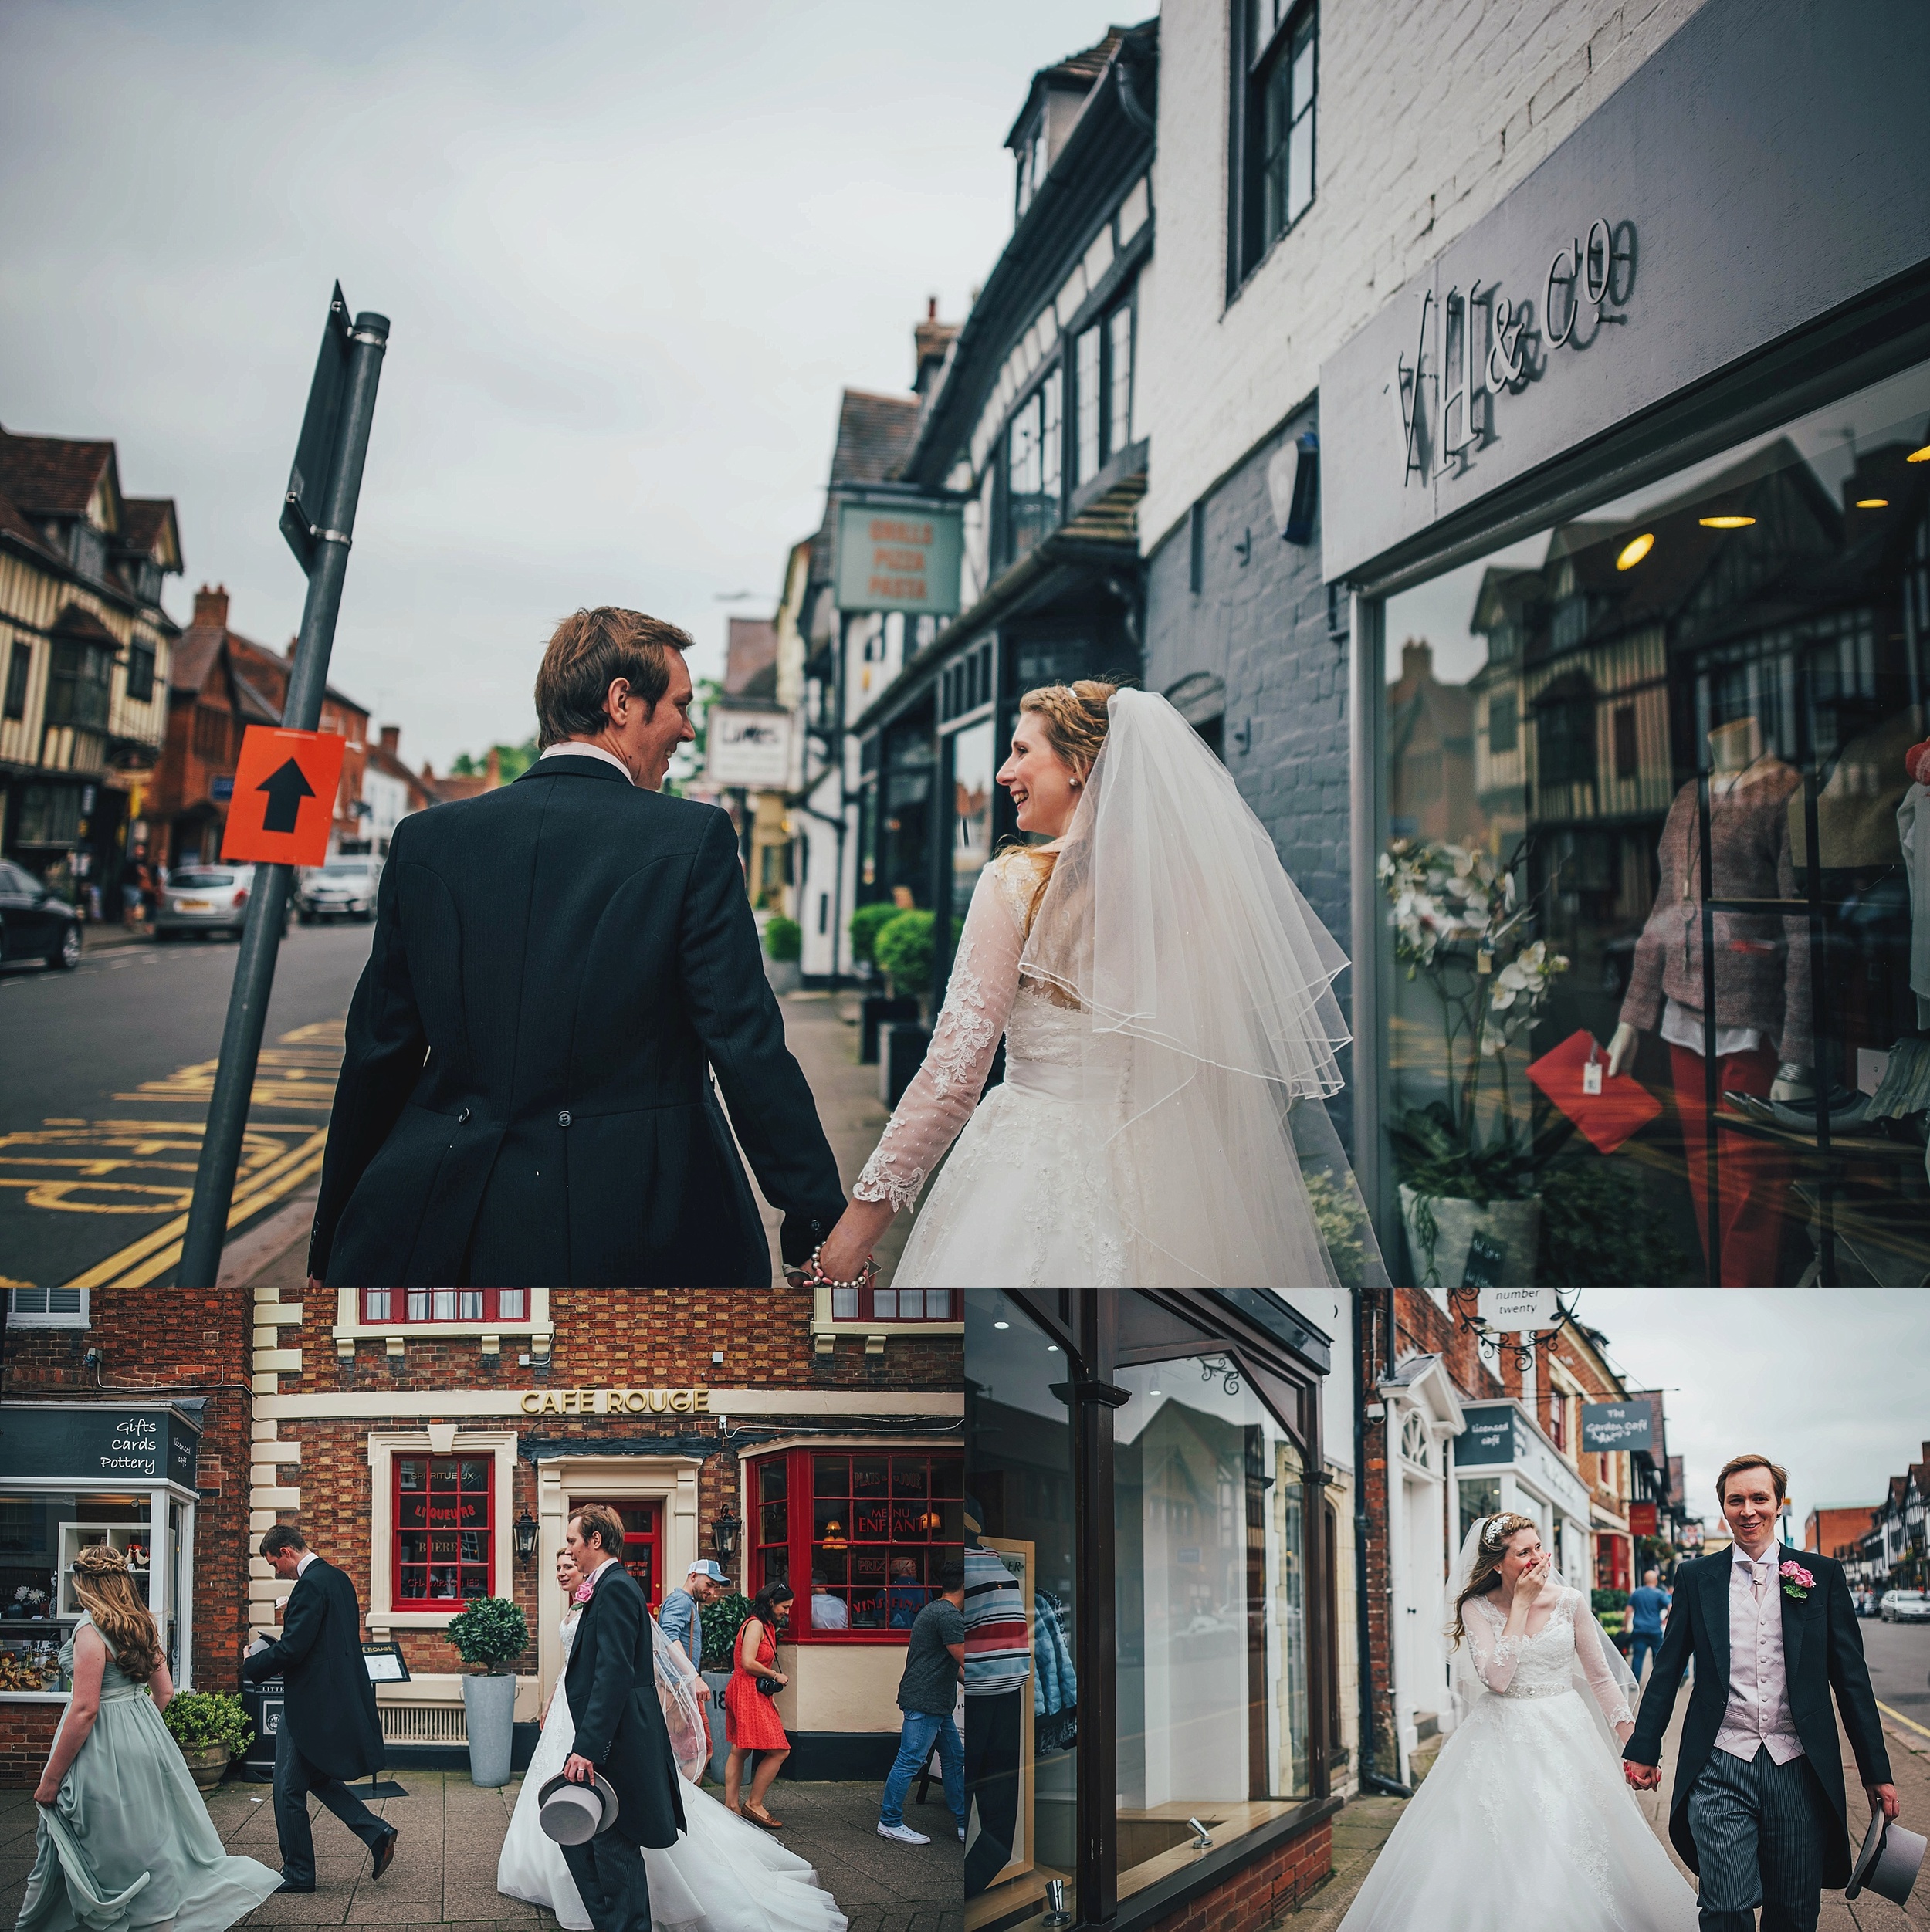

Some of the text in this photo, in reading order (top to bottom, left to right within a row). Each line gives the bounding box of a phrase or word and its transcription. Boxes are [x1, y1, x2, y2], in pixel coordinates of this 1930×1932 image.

[1485, 297, 1524, 394] &
[1496, 1288, 1540, 1300] number
[1499, 1304, 1537, 1314] twenty
[520, 1384, 710, 1414] CAFÉ ROUGE
[1607, 1409, 1626, 1419] The
[117, 1418, 157, 1436] Gifts
[111, 1437, 157, 1450] Cards
[100, 1457, 155, 1475] Pottery
[854, 1472, 880, 1488] PLATS
[415, 1505, 476, 1520] LIQUEURS
[872, 1508, 910, 1518] MENU
[858, 1517, 926, 1532] ENFANT
[858, 1559, 885, 1572] PRIX
[852, 1598, 922, 1613] VINS FINS
